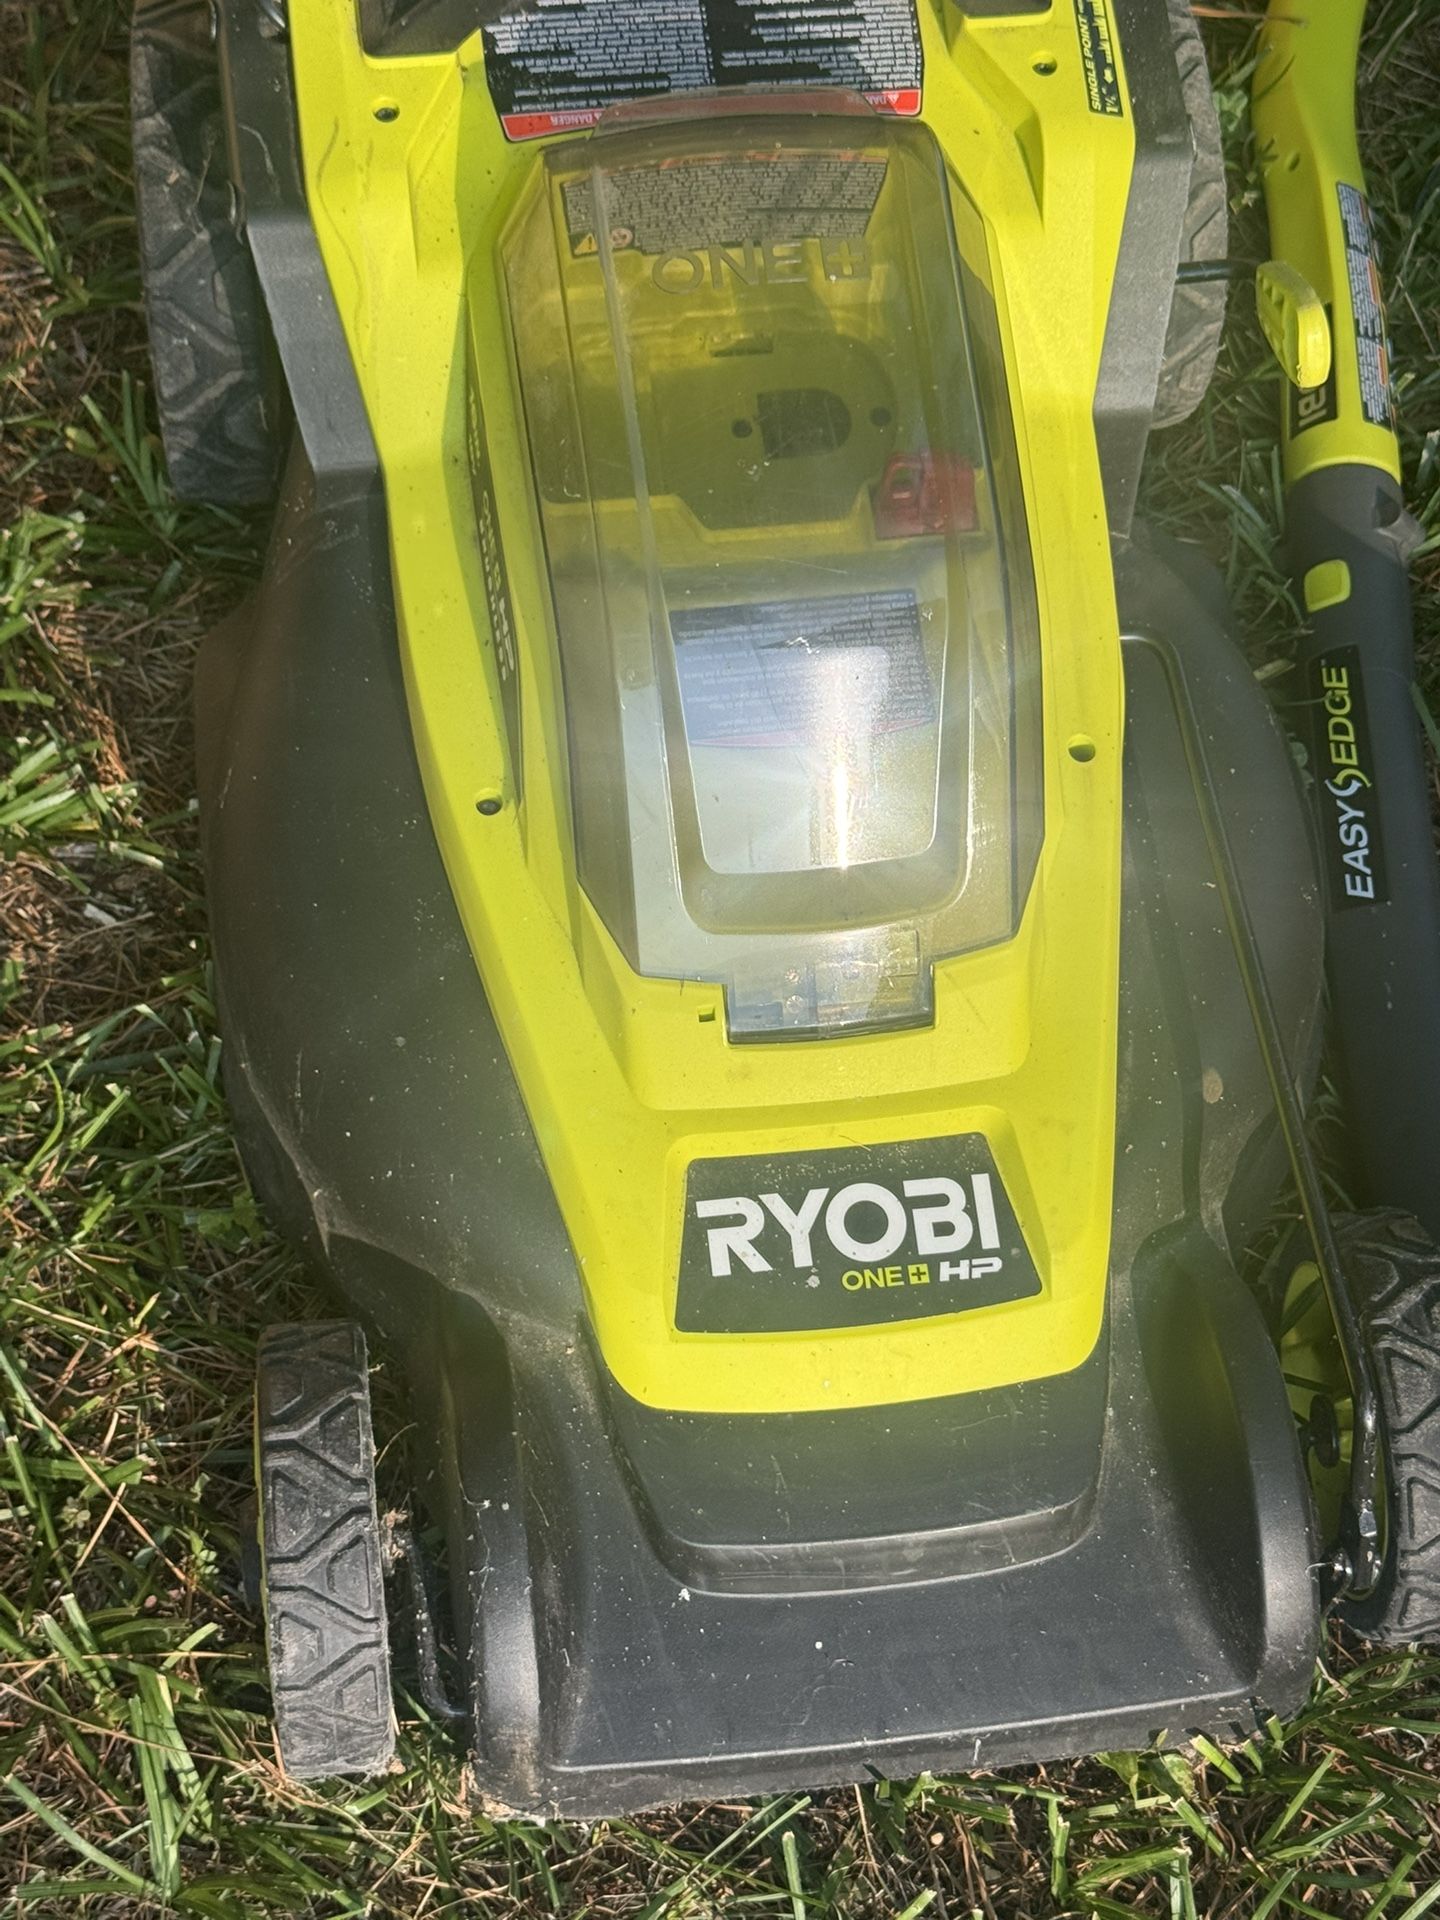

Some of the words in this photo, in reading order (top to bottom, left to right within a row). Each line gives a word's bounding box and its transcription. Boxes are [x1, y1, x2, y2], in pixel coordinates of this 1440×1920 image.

[1077, 14, 1094, 59] POINT
[1085, 58, 1102, 111] SINGLE
[1321, 666, 1360, 767] EDGE
[1336, 799, 1376, 900] EASY
[696, 1172, 1001, 1278] RYOBI
[938, 1256, 1003, 1282] HP
